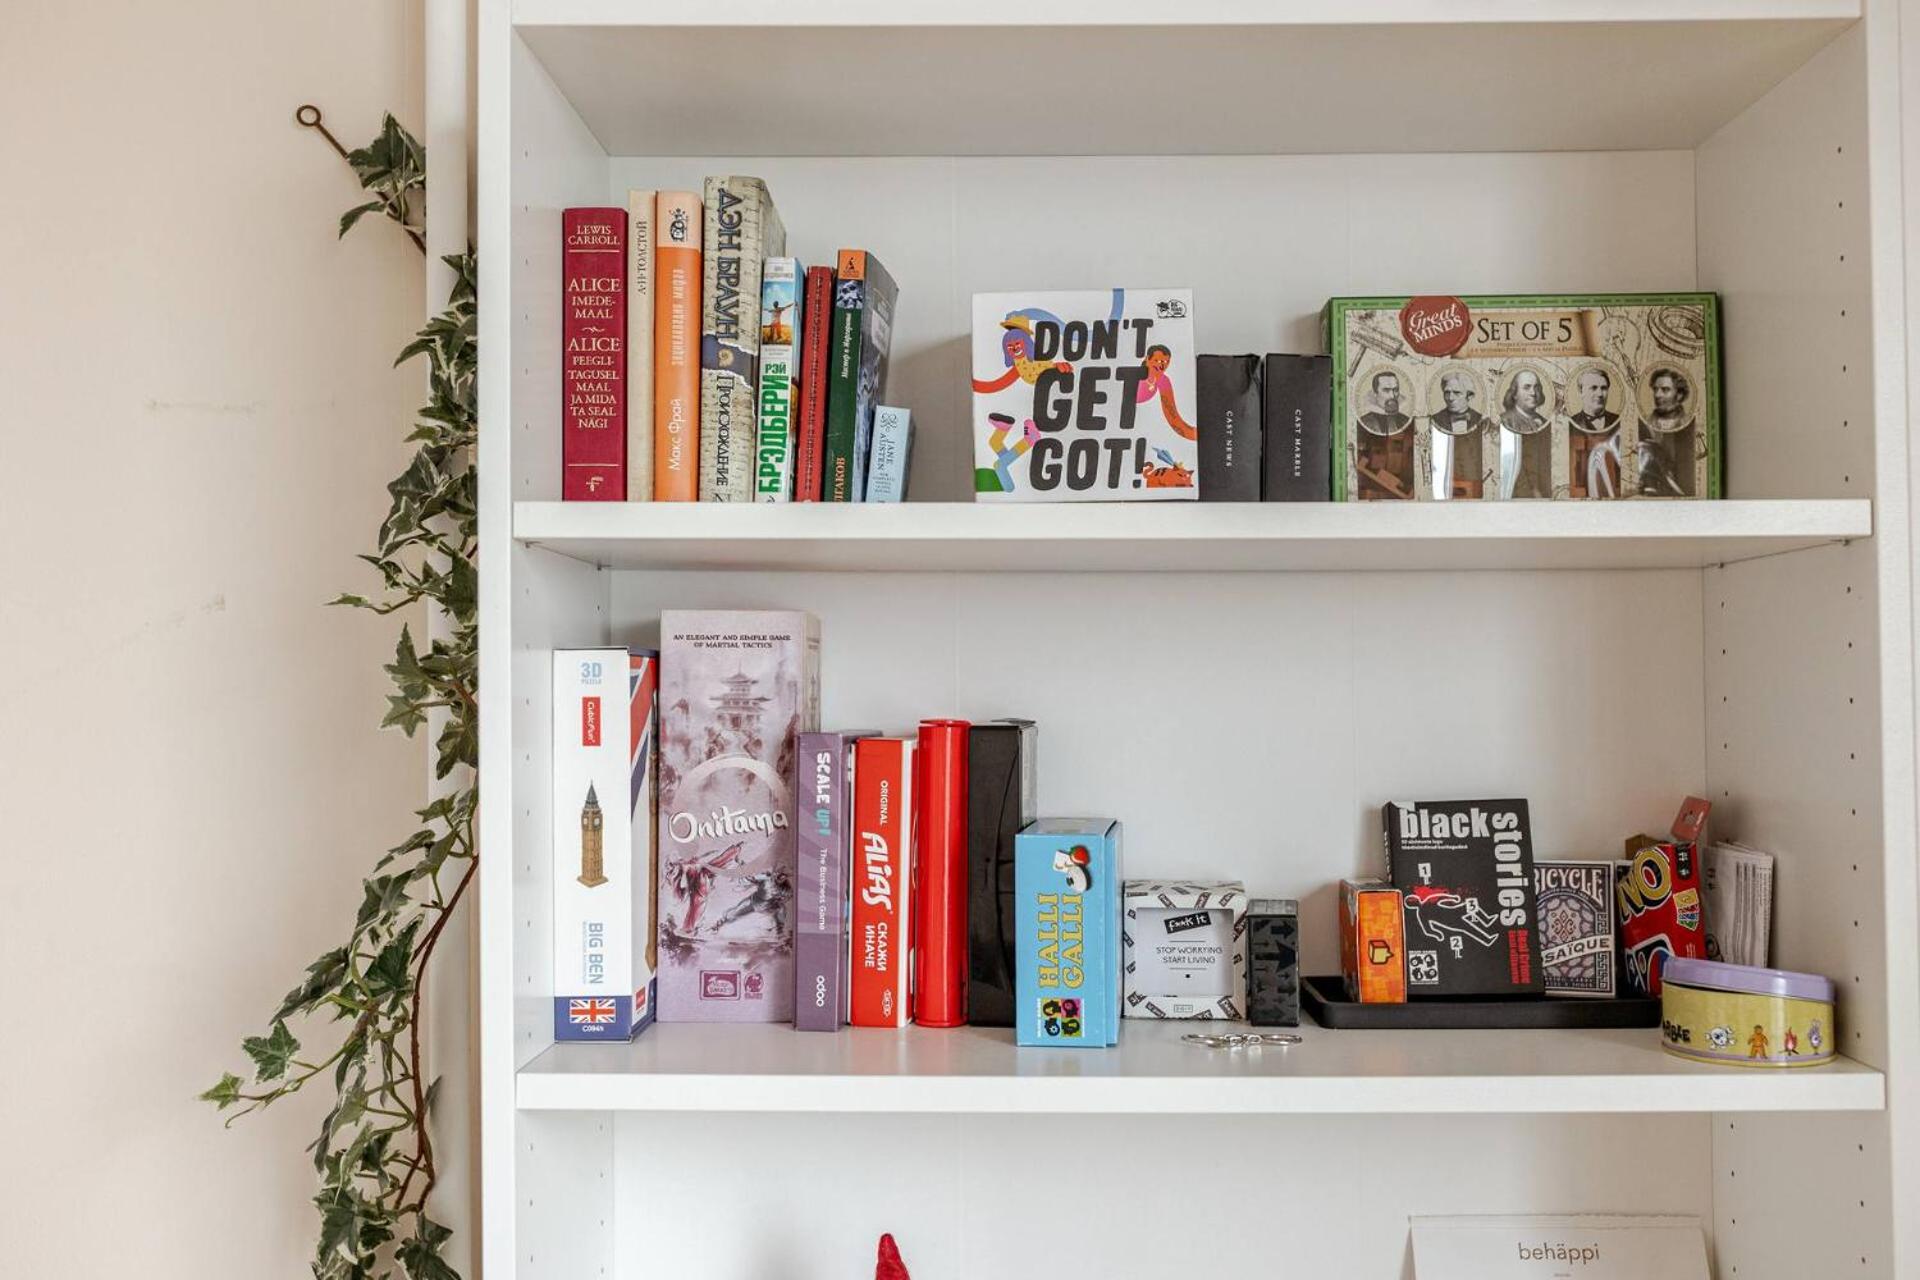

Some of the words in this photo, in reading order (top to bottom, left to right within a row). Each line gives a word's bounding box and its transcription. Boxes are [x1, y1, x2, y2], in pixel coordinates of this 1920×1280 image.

[576, 225, 612, 235] LEWIS
[718, 188, 742, 250] ДЭН
[567, 235, 620, 245] CARROLL
[568, 278, 622, 292] ALICE
[714, 256, 742, 340] БРАУН
[572, 296, 616, 306] IMEDE-
[575, 309, 613, 319] MAAL
[1409, 303, 1458, 333] Great
[1413, 315, 1463, 344] MINDS
[1557, 318, 1572, 343] 5
[568, 338, 621, 352] ALICE
[1033, 319, 1154, 362] DON'T
[567, 370, 620, 380] TAGUSEL
[572, 355, 615, 366] PEEGLI-
[764, 361, 787, 375] РЭЙ
[571, 394, 583, 405] JA
[585, 394, 617, 404] MIDA
[576, 382, 611, 392] MAAL
[1033, 366, 1149, 432] GET
[570, 406, 586, 416] TA
[588, 406, 617, 416] SEAL
[667, 398, 684, 434] Фрай
[1225, 410, 1234, 435] CAST
[1294, 409, 1302, 434] CAST
[758, 374, 789, 493] БРЭДБЕРИ
[668, 437, 682, 471] Макс
[1029, 438, 1147, 491] GOT!
[1225, 440, 1233, 467] NEWS
[1294, 438, 1302, 477] MARBLE
[834, 456, 846, 502] ЛГАКОВ
[580, 662, 602, 678] 3D
[816, 752, 831, 804] SCALE
[879, 780, 889, 825] ORIGINAL
[669, 805, 789, 844] Onitama
[1400, 808, 1490, 839] black
[819, 848, 828, 865] The
[1492, 812, 1529, 926] stories
[819, 866, 828, 904] Business
[818, 905, 827, 930] Game
[588, 922, 603, 948] BIG
[865, 925, 875, 967] ИНАЧЕ
[876, 922, 888, 971] СКАЖИ
[1038, 892, 1060, 988] HALLI
[1062, 892, 1085, 989] GALLI
[1156, 946, 1176, 954] STOP
[1178, 946, 1222, 954] WORRYING
[1545, 938, 1609, 964] SAÏQUE
[588, 954, 603, 984] BEN
[816, 975, 826, 1007] odoo
[1518, 1242, 1600, 1265] behäppi
